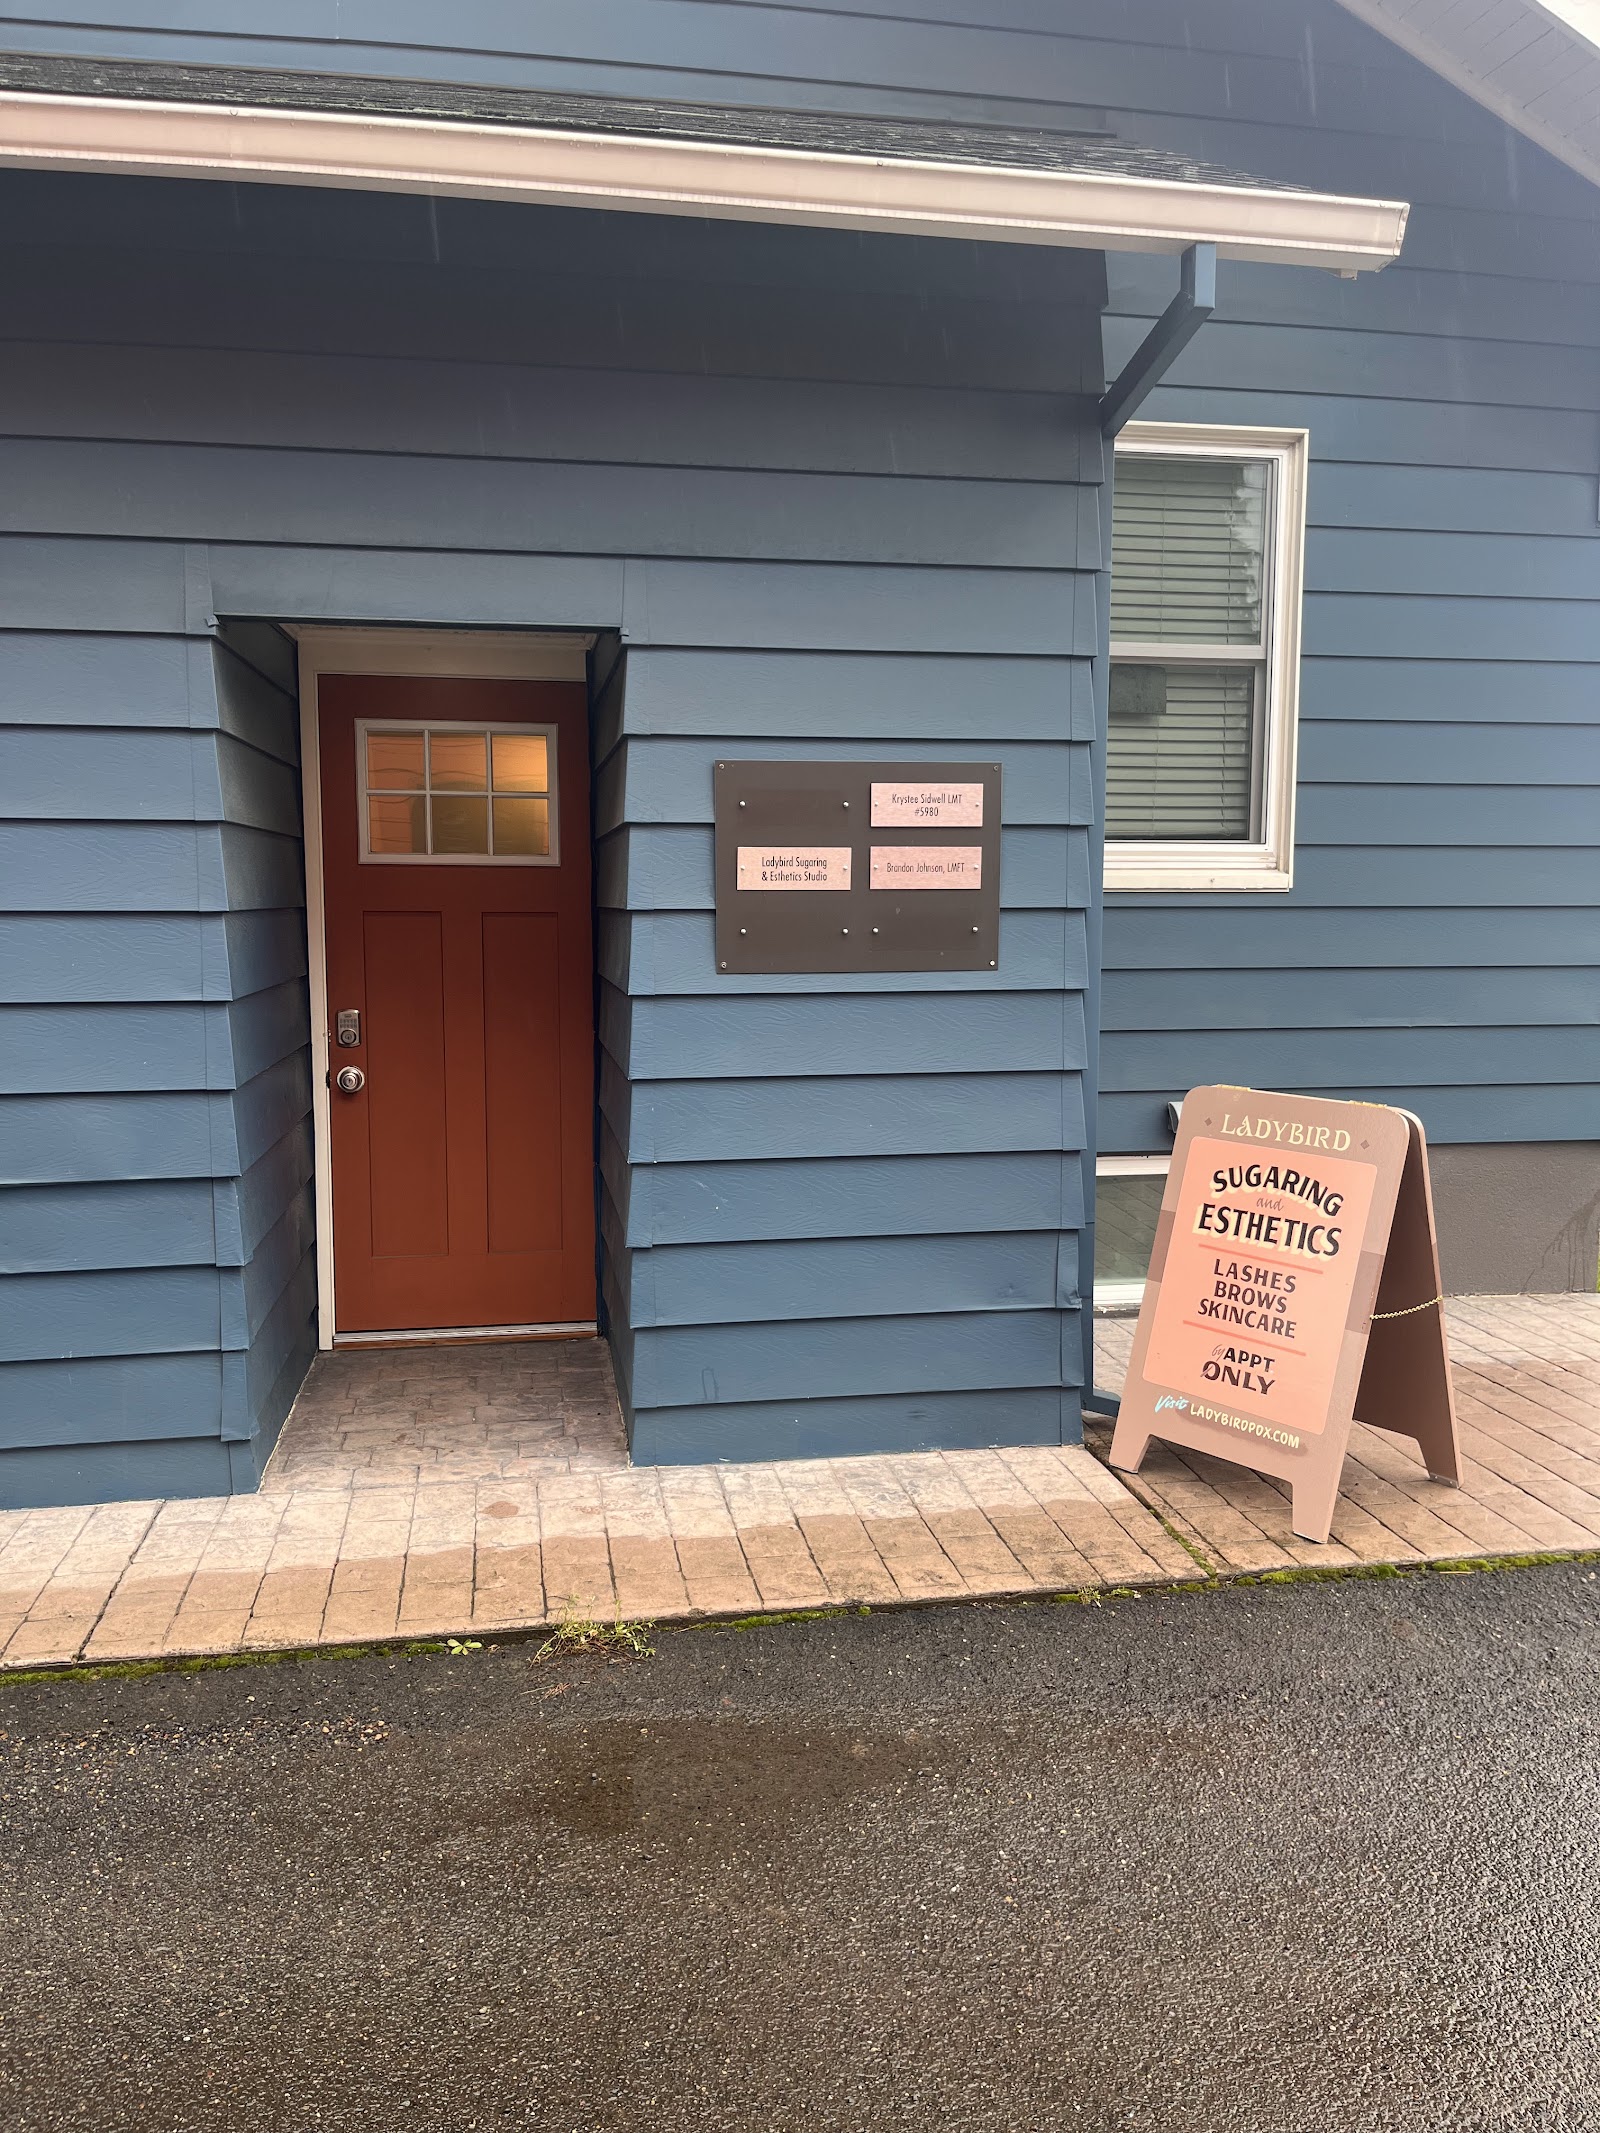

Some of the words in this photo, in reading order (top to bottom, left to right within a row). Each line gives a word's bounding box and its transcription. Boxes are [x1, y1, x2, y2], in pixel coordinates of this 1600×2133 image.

[892, 793, 919, 805] Krystee
[921, 793, 946, 804] Sidwell
[948, 794, 962, 804] LMT
[915, 807, 939, 817] #5980
[762, 856, 794, 869] Ladybird
[796, 856, 827, 869] Sugaring
[762, 871, 768, 881] &
[770, 870, 802, 881] Esthetics
[804, 870, 827, 881] Studio
[886, 862, 914, 873] Brandon
[916, 862, 945, 874] Johnson,
[947, 862, 965, 873] LMFT
[1220, 1113, 1351, 1151] LADYBIRD
[1211, 1163, 1345, 1217] SUGARING
[1256, 1195, 1285, 1212] and
[1196, 1203, 1342, 1258] ESTHETICS
[1213, 1258, 1297, 1293] LASHES
[1213, 1280, 1288, 1314] BROWS
[1197, 1298, 1298, 1339] SKINCARE
[1201, 1360, 1276, 1395] ONLY
[1154, 1395, 1190, 1413] Visit
